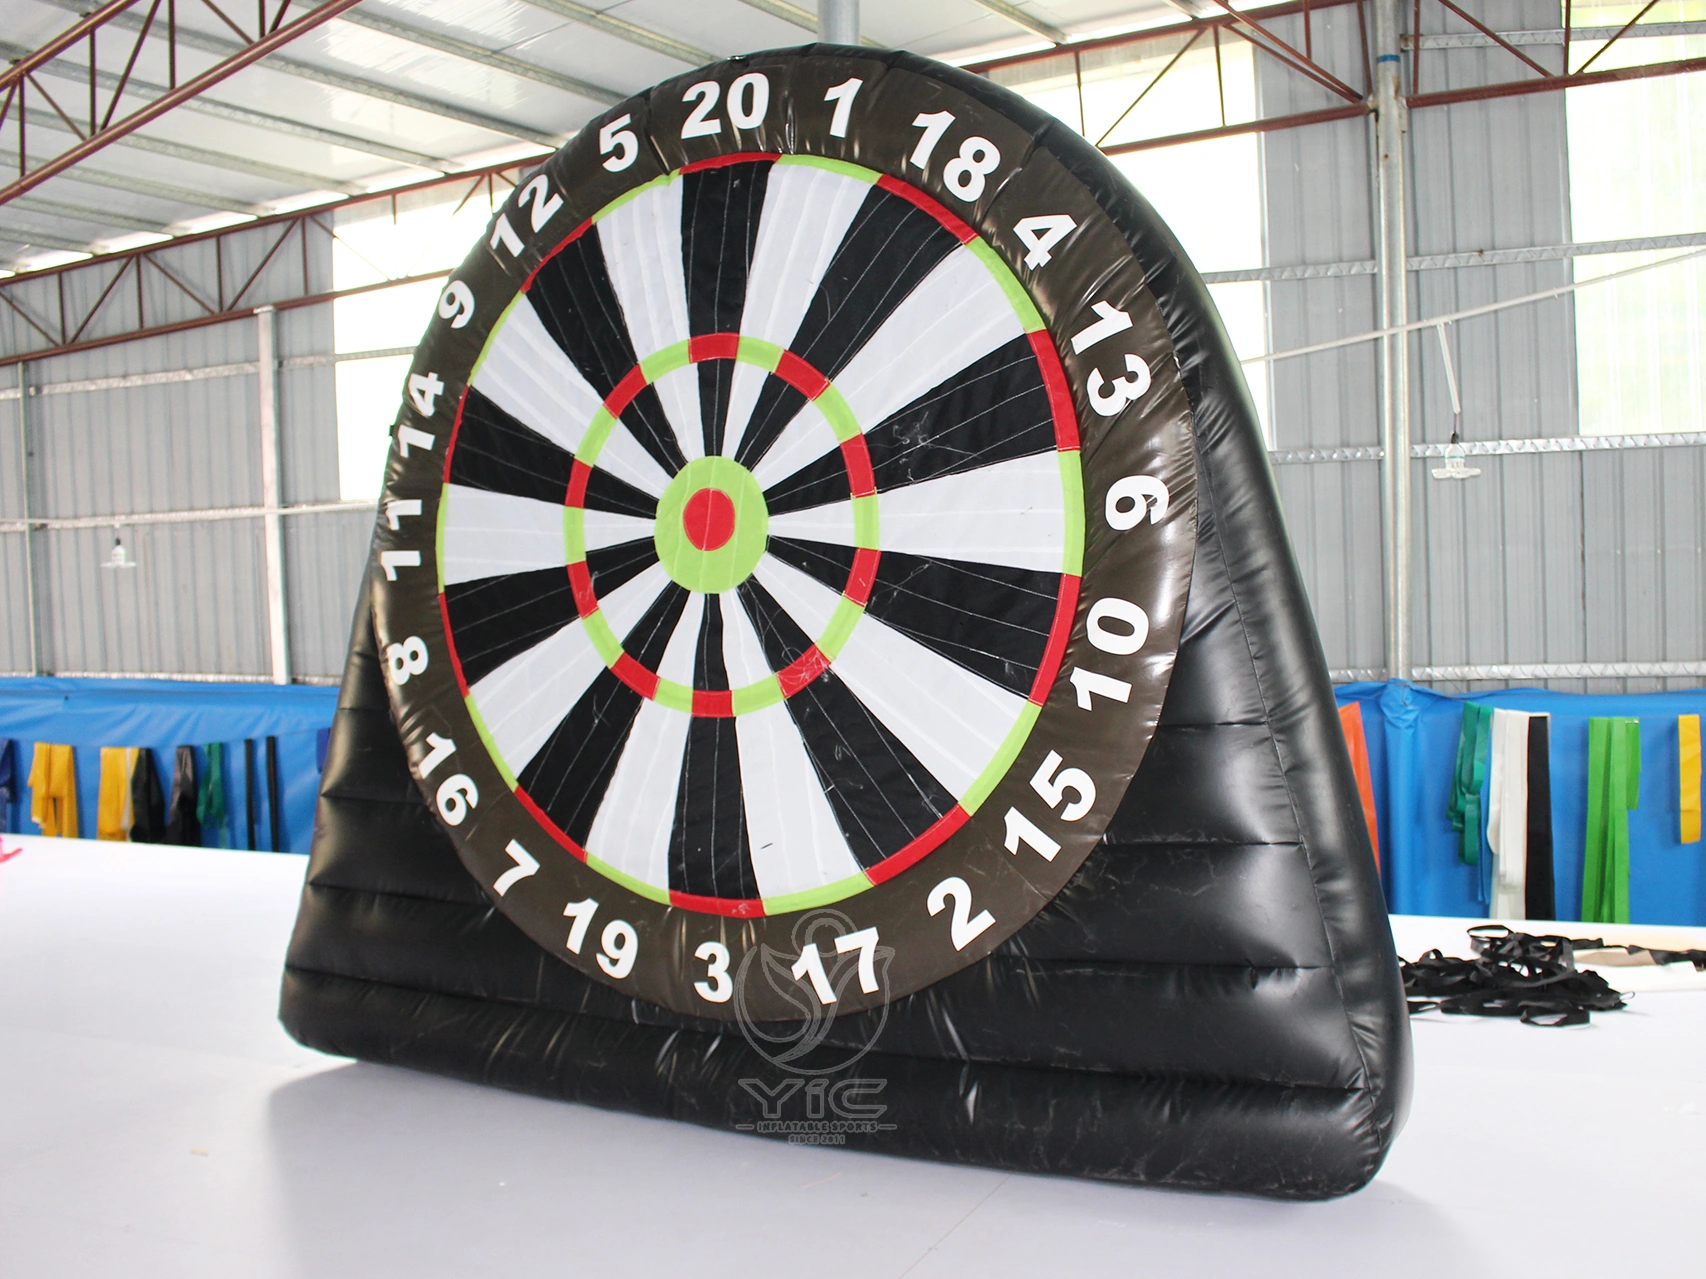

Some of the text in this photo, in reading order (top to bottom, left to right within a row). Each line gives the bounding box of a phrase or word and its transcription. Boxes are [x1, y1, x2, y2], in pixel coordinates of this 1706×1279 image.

[600, 114, 639, 172] 5
[681, 73, 770, 140] 20
[824, 78, 863, 138] 1
[910, 111, 1001, 202] 18
[490, 174, 564, 258] 12
[1013, 214, 1077, 270] 4
[438, 280, 475, 329] 9
[1070, 301, 1151, 417] 13
[398, 372, 445, 459] 14
[381, 500, 422, 581] 11
[1105, 475, 1170, 531] 6
[388, 636, 428, 685] 8
[1070, 598, 1149, 711] 10
[420, 733, 479, 826] 16
[1003, 750, 1096, 862] 15
[494, 840, 540, 897] 7
[563, 899, 638, 979] 19
[927, 877, 995, 951] 2
[694, 942, 734, 1003] 3
[791, 927, 880, 1005] 17
